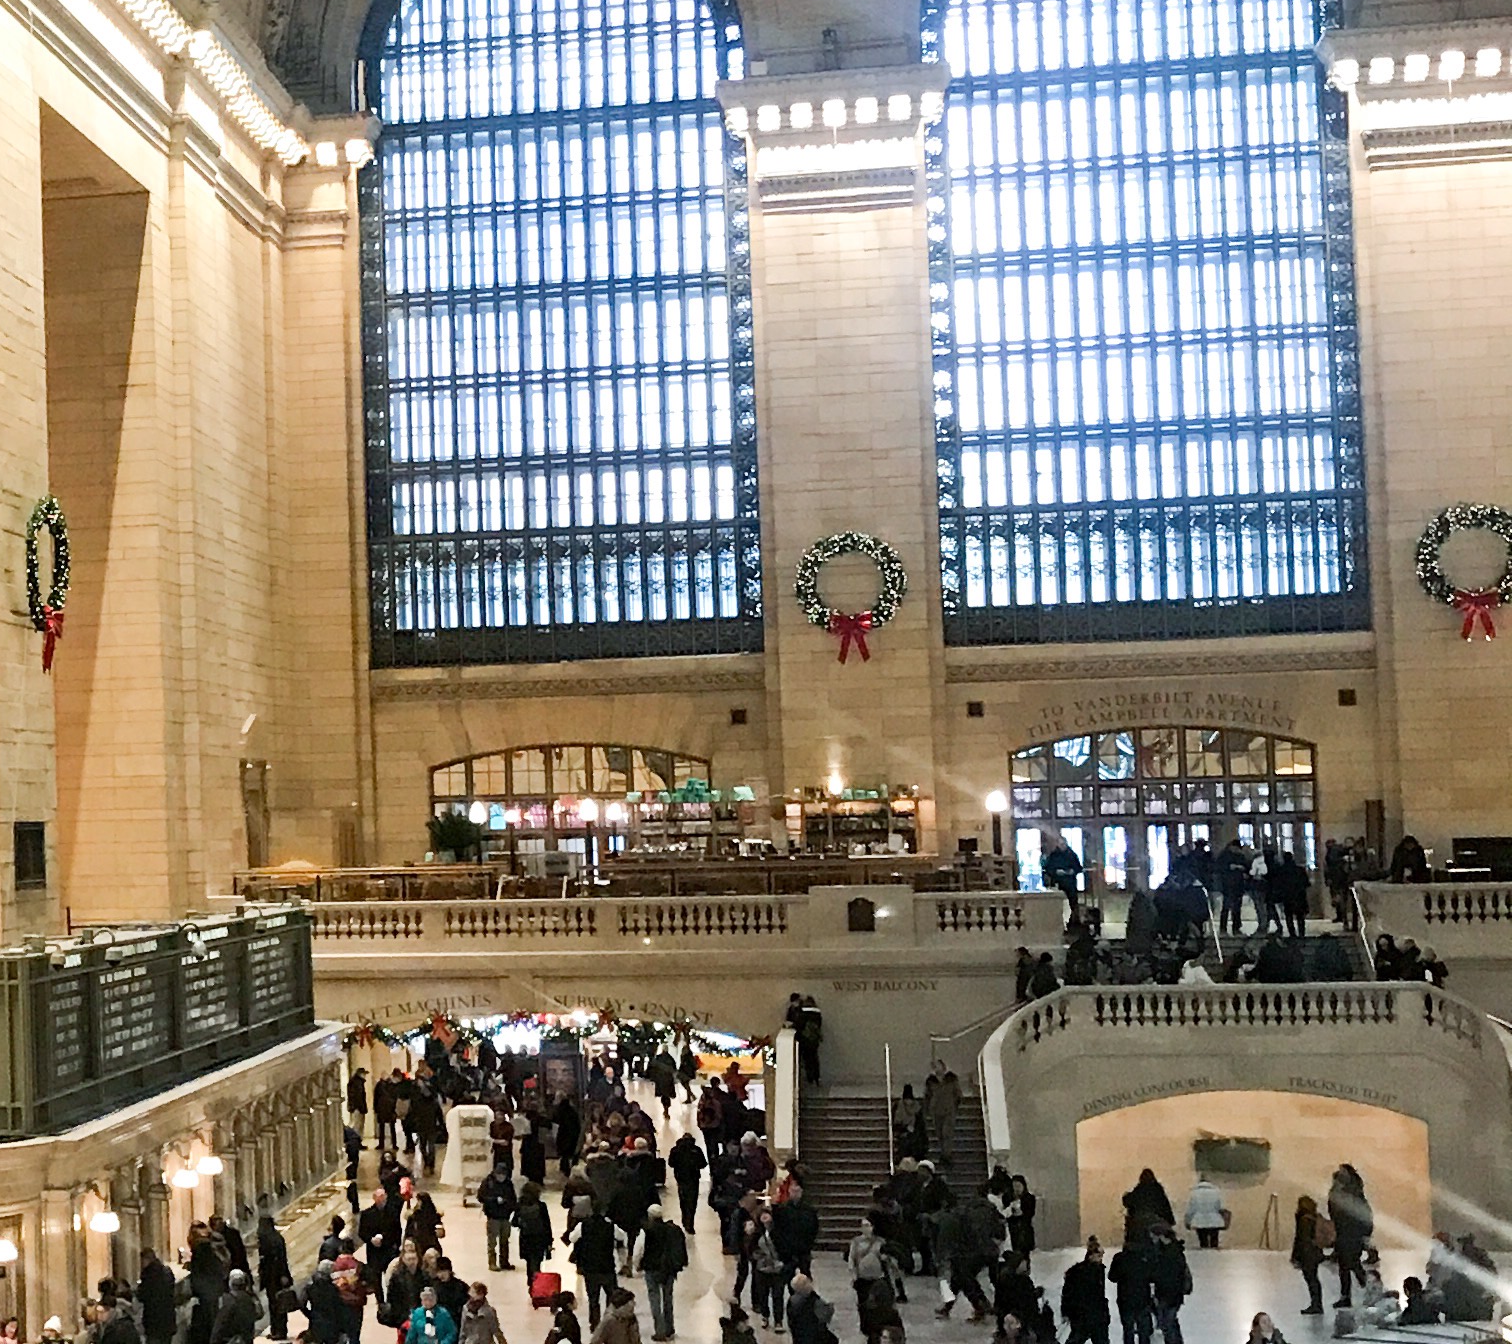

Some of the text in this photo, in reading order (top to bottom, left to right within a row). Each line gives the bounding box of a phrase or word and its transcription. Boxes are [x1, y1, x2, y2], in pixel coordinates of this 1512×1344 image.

[1073, 691, 1194, 713] VANDERBILT
[1206, 692, 1283, 711] AVENUE
[1074, 706, 1170, 728] CAMPBELL
[1183, 708, 1297, 733] APARTMENT
[832, 980, 939, 992] WEST BALCONY
[340, 994, 492, 1024] ICKET MACHINES
[553, 995, 714, 1026] SUBWAY 42ND ST
